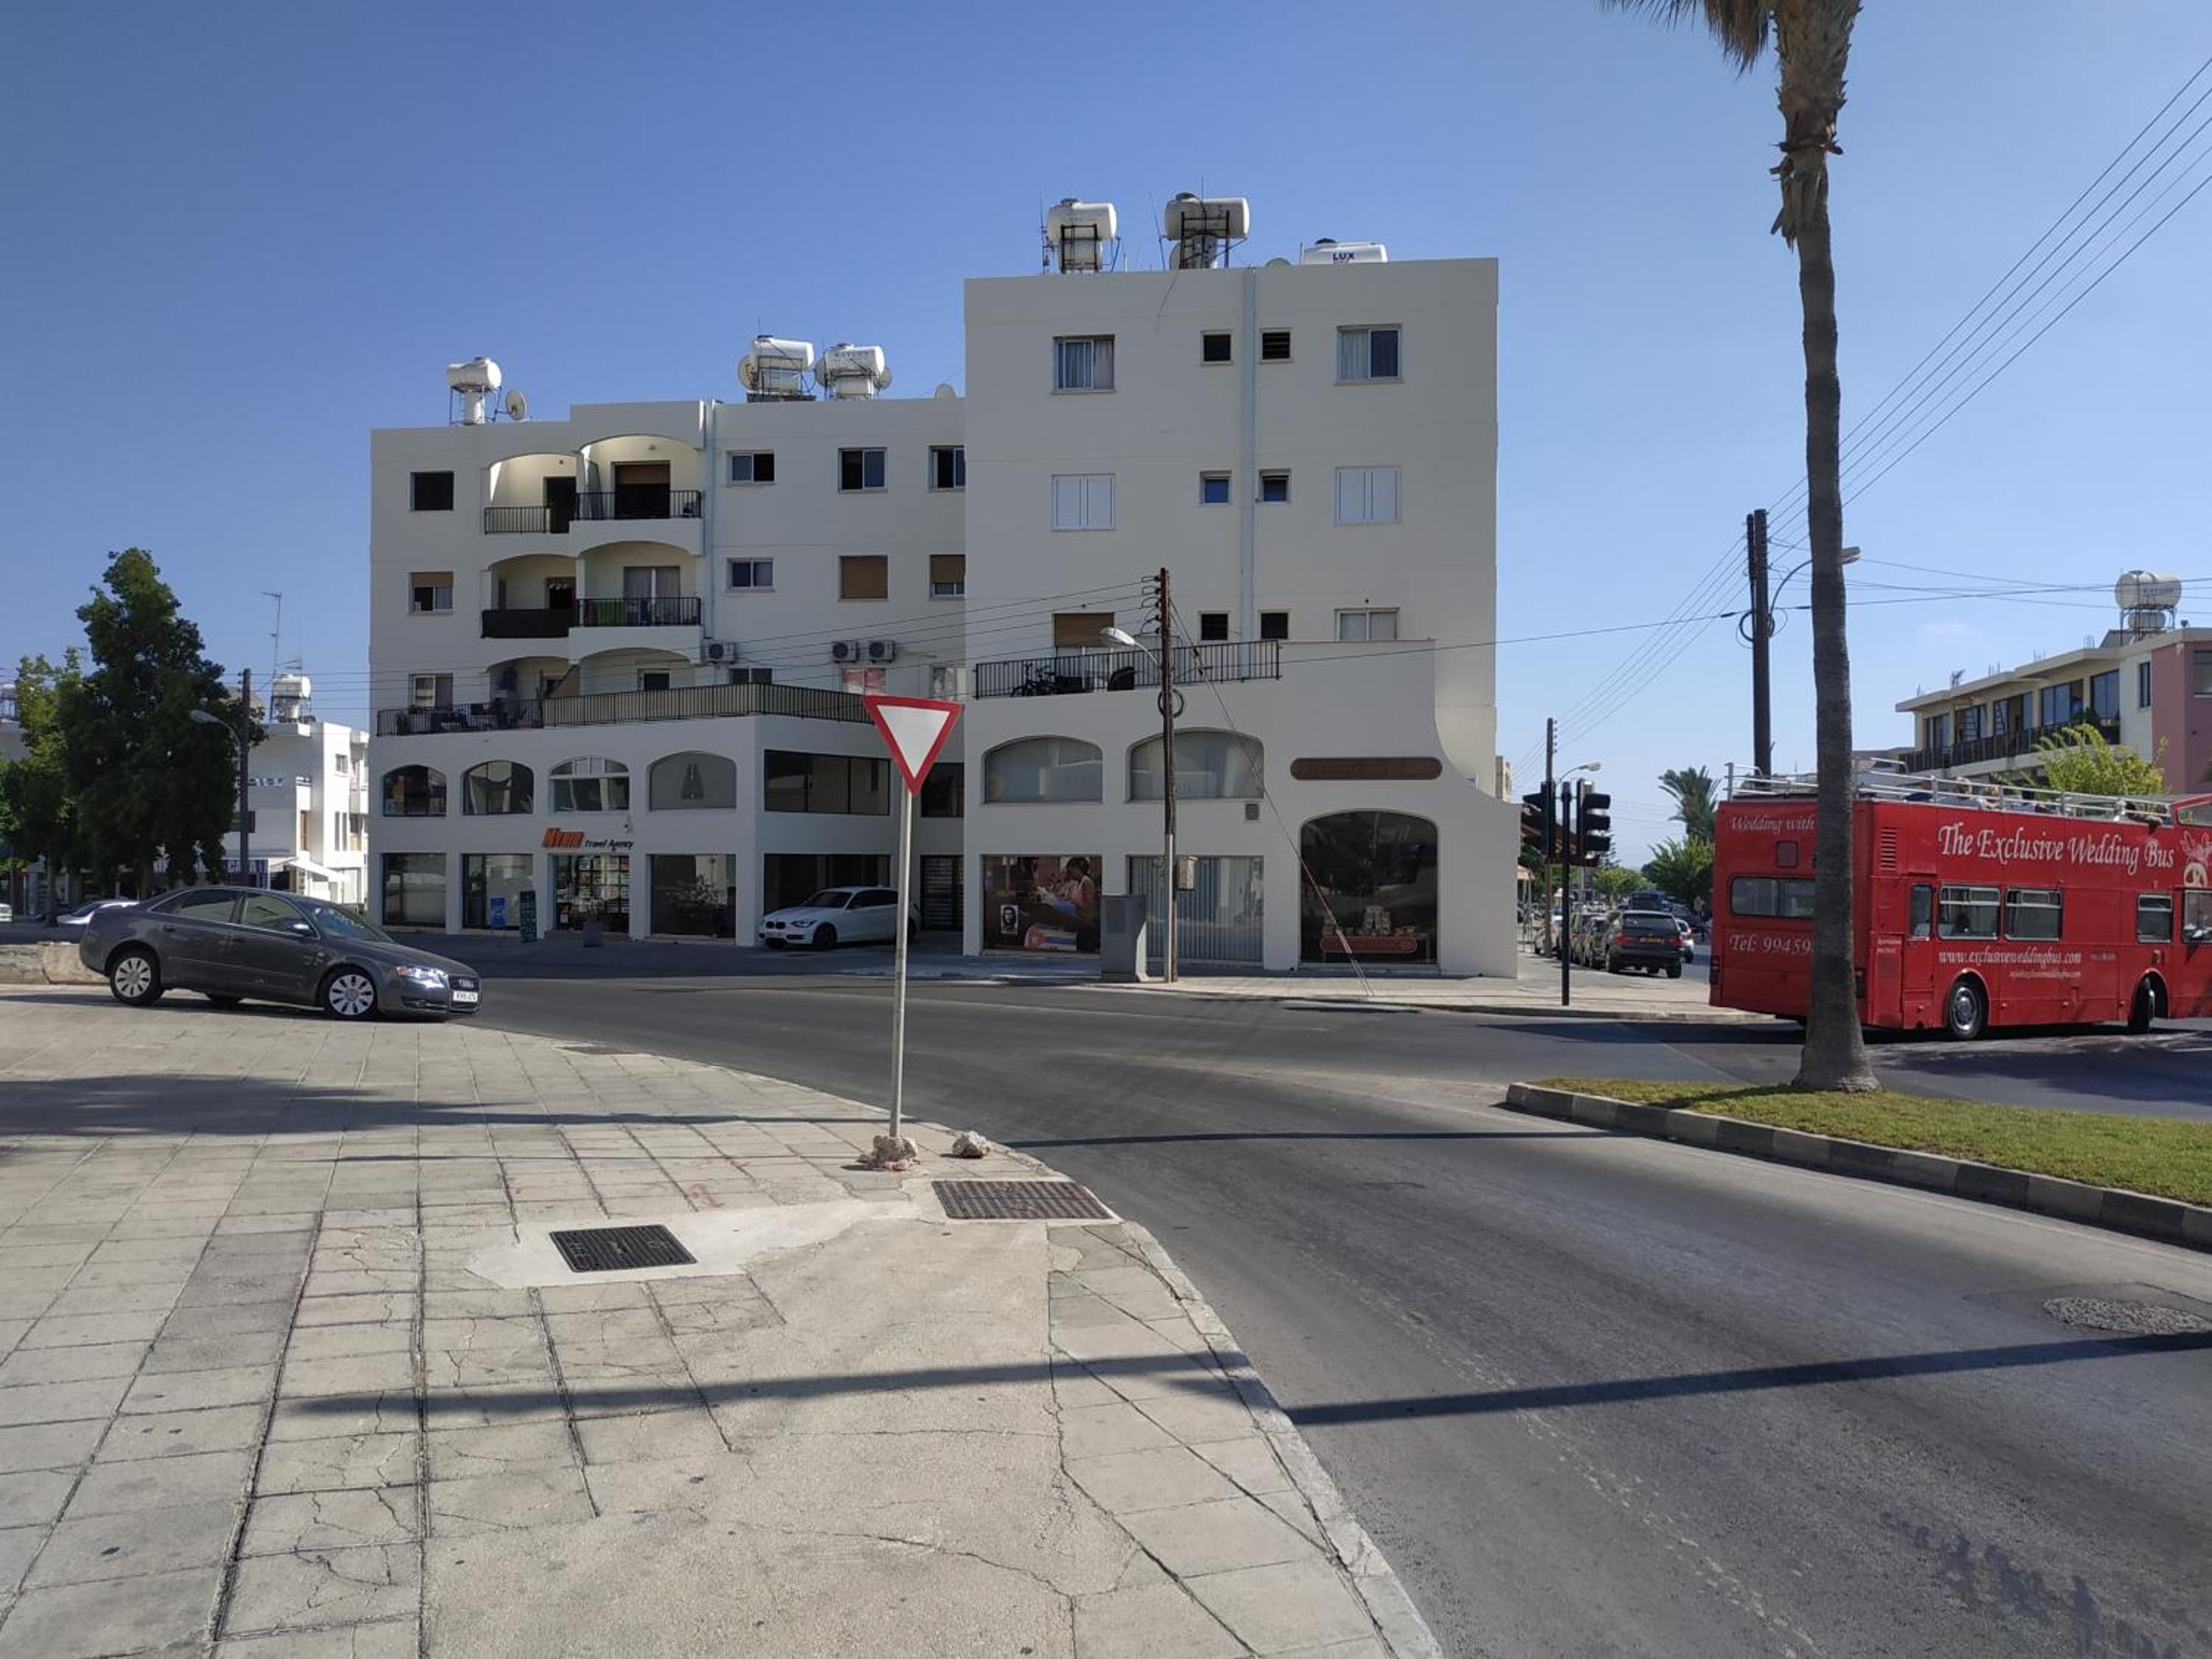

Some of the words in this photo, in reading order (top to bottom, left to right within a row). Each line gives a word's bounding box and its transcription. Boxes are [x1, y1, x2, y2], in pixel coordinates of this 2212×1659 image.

[1332, 252, 1355, 260] LUX
[1730, 813, 1782, 835] Wedding
[1785, 814, 1815, 830] with
[1938, 821, 1973, 857] The
[1977, 827, 2064, 865] Exclusive
[2067, 832, 2139, 875] Wedding
[2144, 838, 2174, 869] Bus
[1763, 936, 1815, 956] 99459
[1938, 945, 2082, 969] www.exclusiveweddingbus.com
